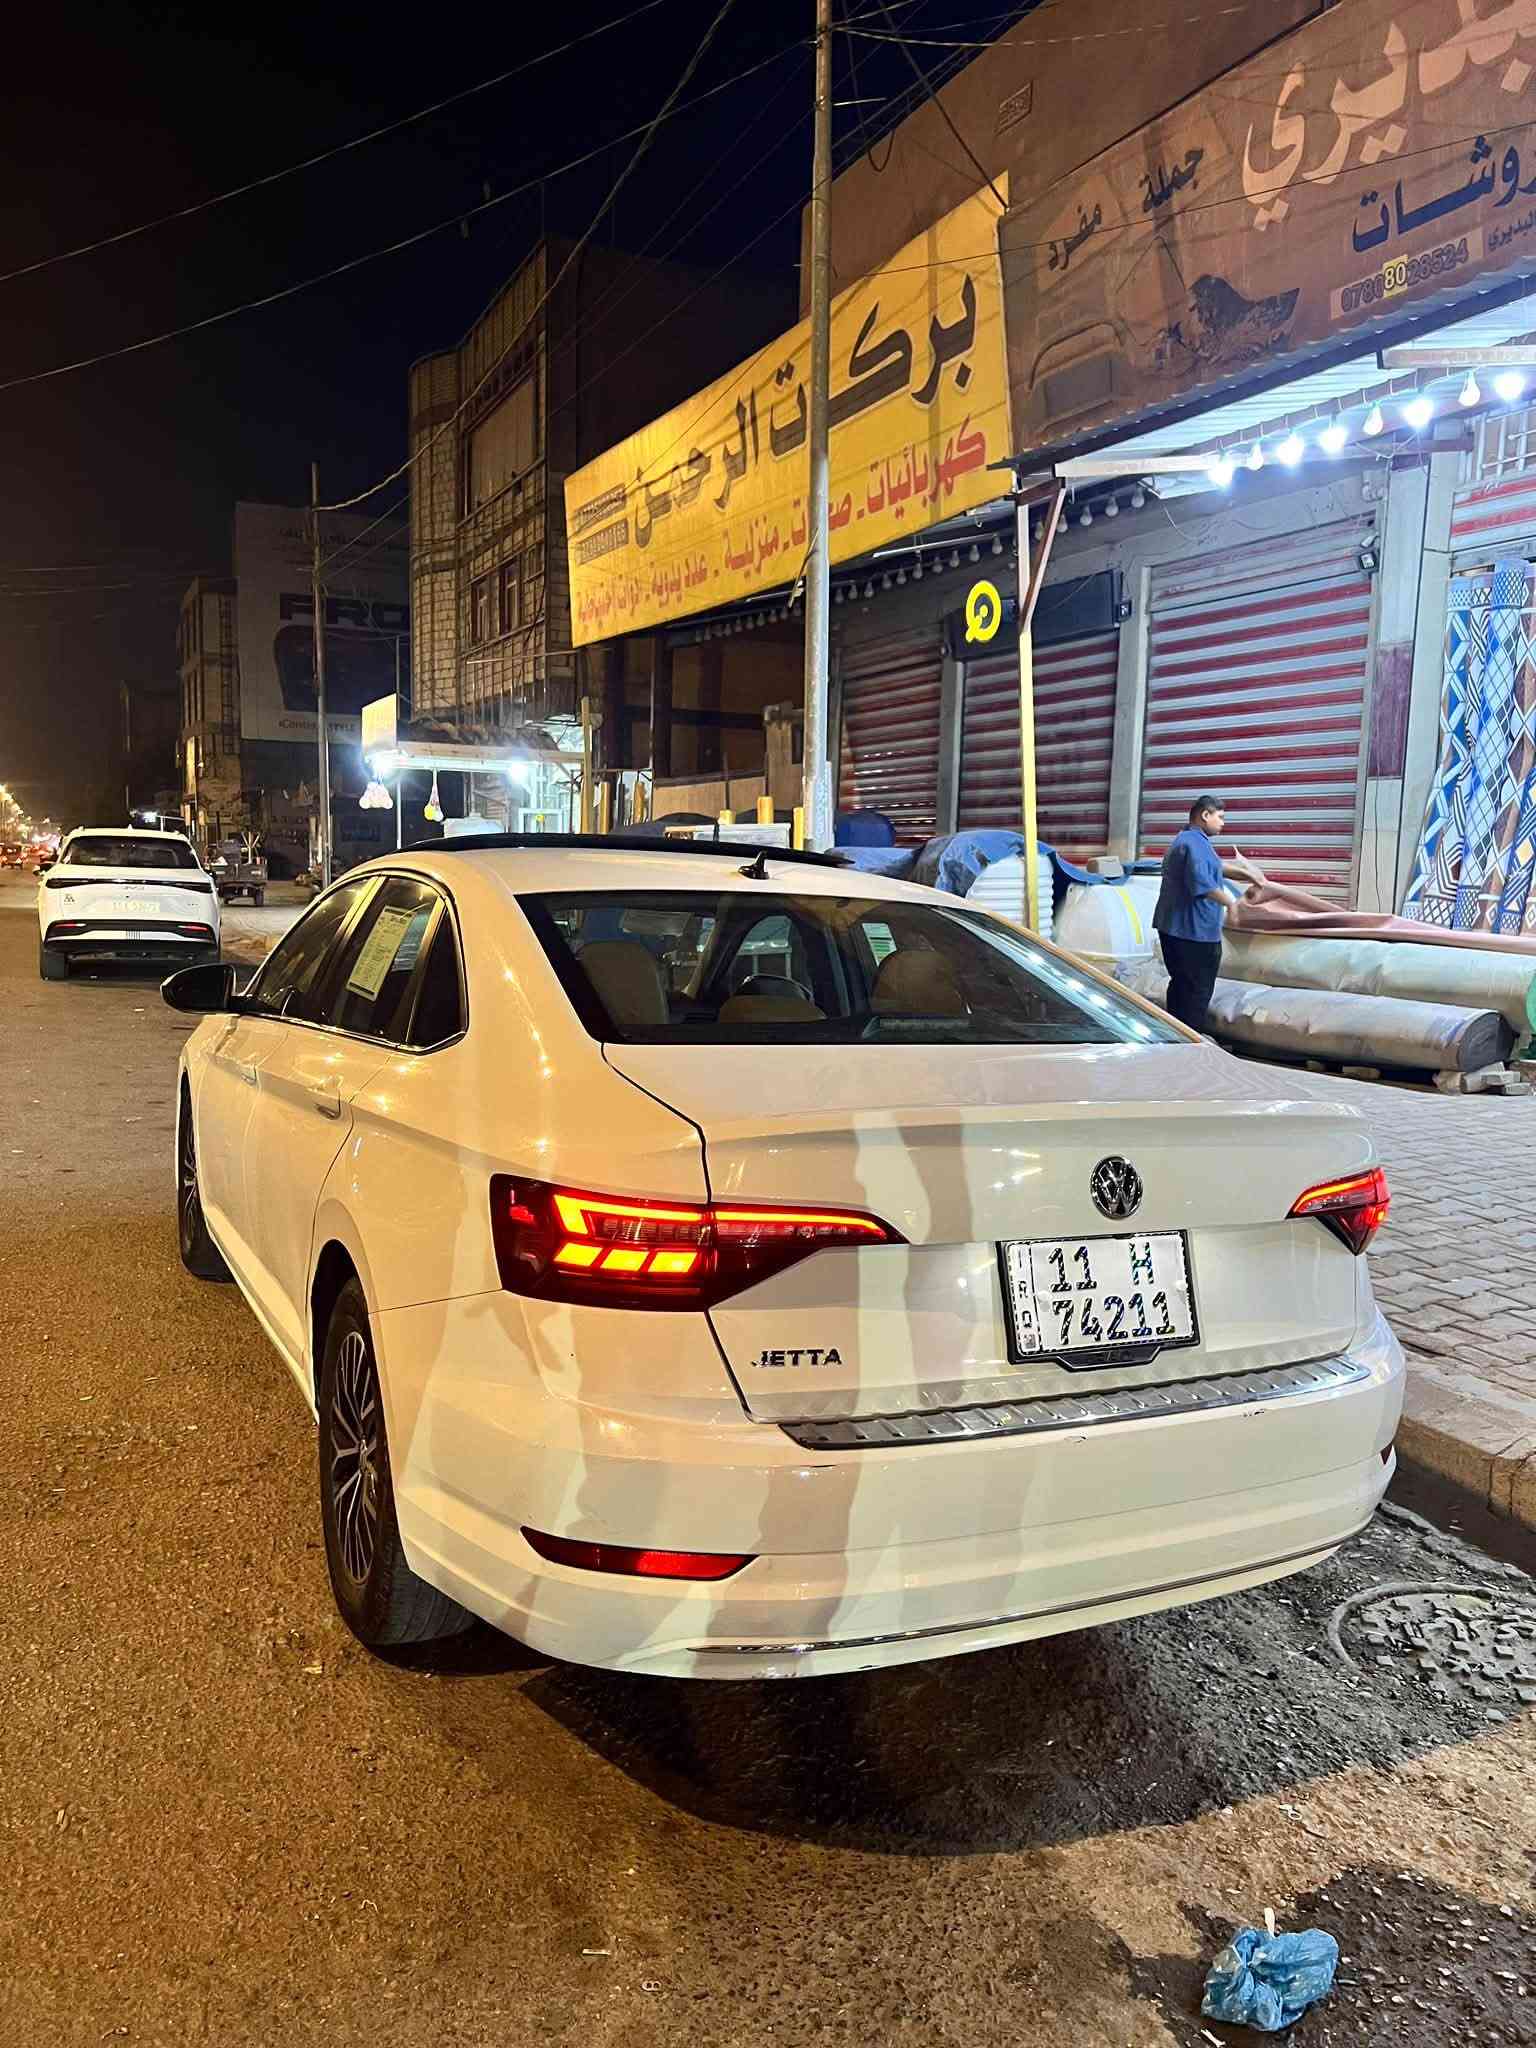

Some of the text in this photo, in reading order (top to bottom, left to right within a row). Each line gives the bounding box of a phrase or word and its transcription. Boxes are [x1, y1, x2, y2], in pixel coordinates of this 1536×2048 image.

[1048, 1240, 1154, 1292] 11 H
[1052, 1291, 1175, 1345] 74211
